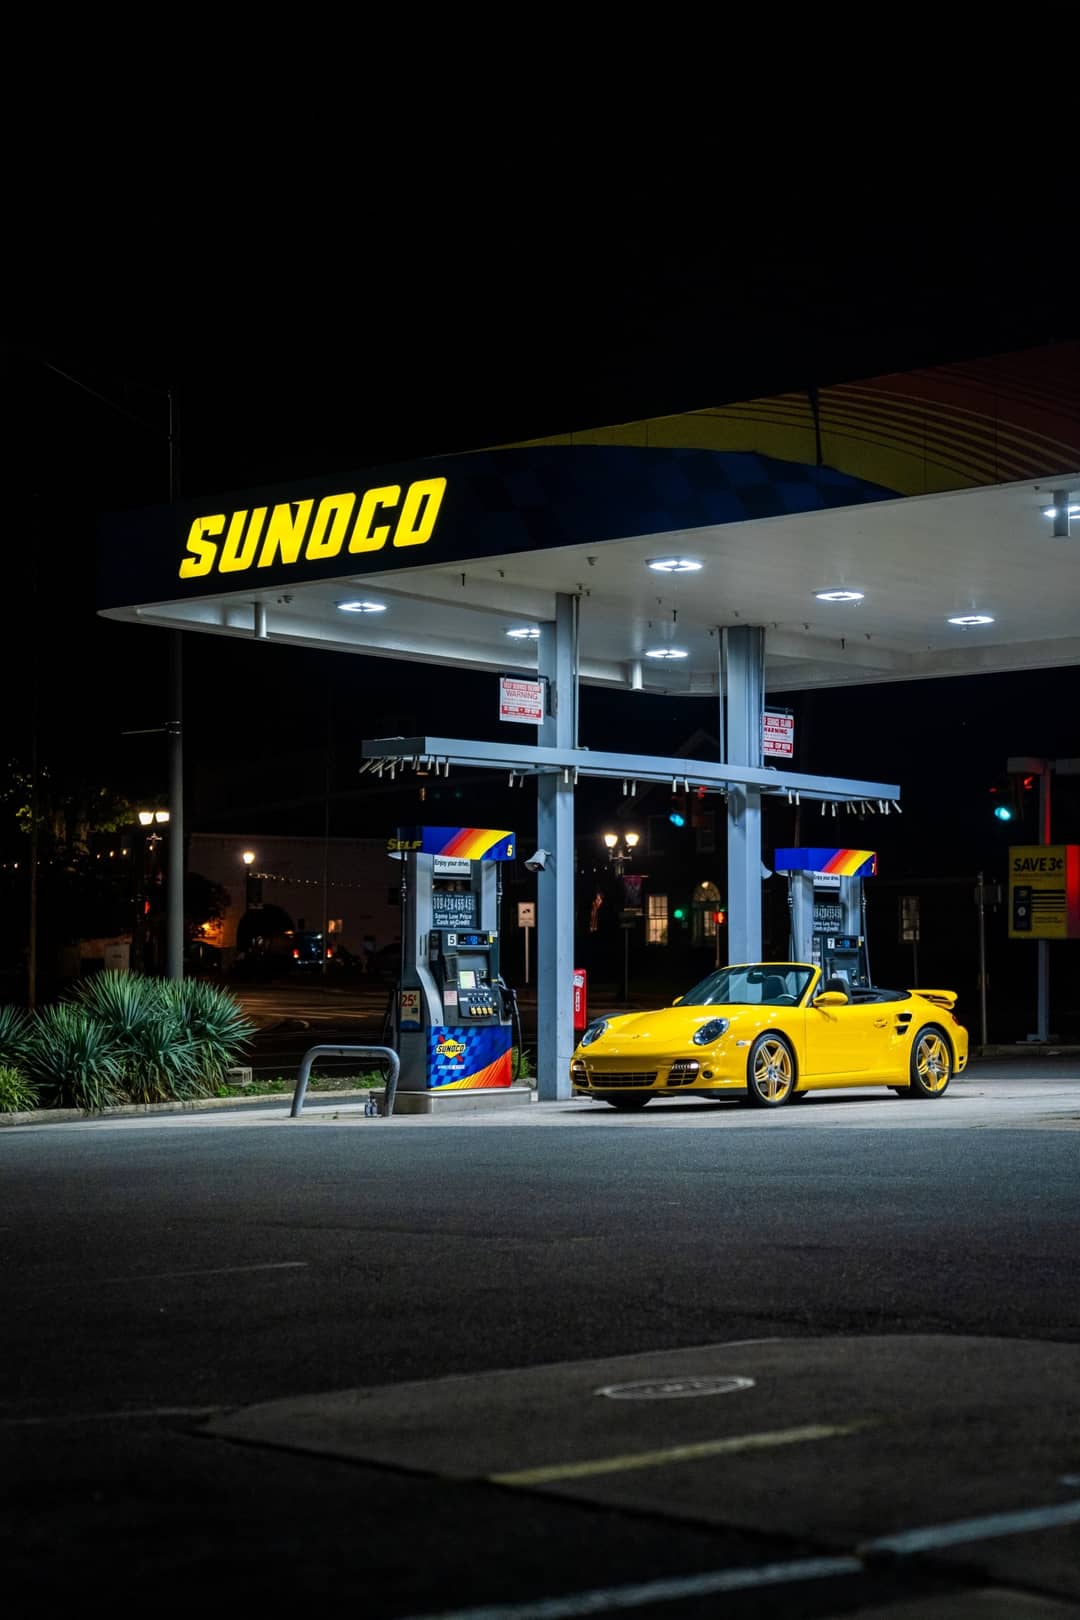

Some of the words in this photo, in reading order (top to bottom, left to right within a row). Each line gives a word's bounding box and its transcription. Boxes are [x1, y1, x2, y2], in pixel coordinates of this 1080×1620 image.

[178, 476, 447, 579] SUNOCO
[505, 690, 538, 700] WARNING
[387, 838, 422, 850] SELF
[506, 844, 513, 856] 5
[1014, 857, 1047, 871] SAVE
[449, 935, 455, 944] 5
[437, 1044, 465, 1053] SUNOCO
